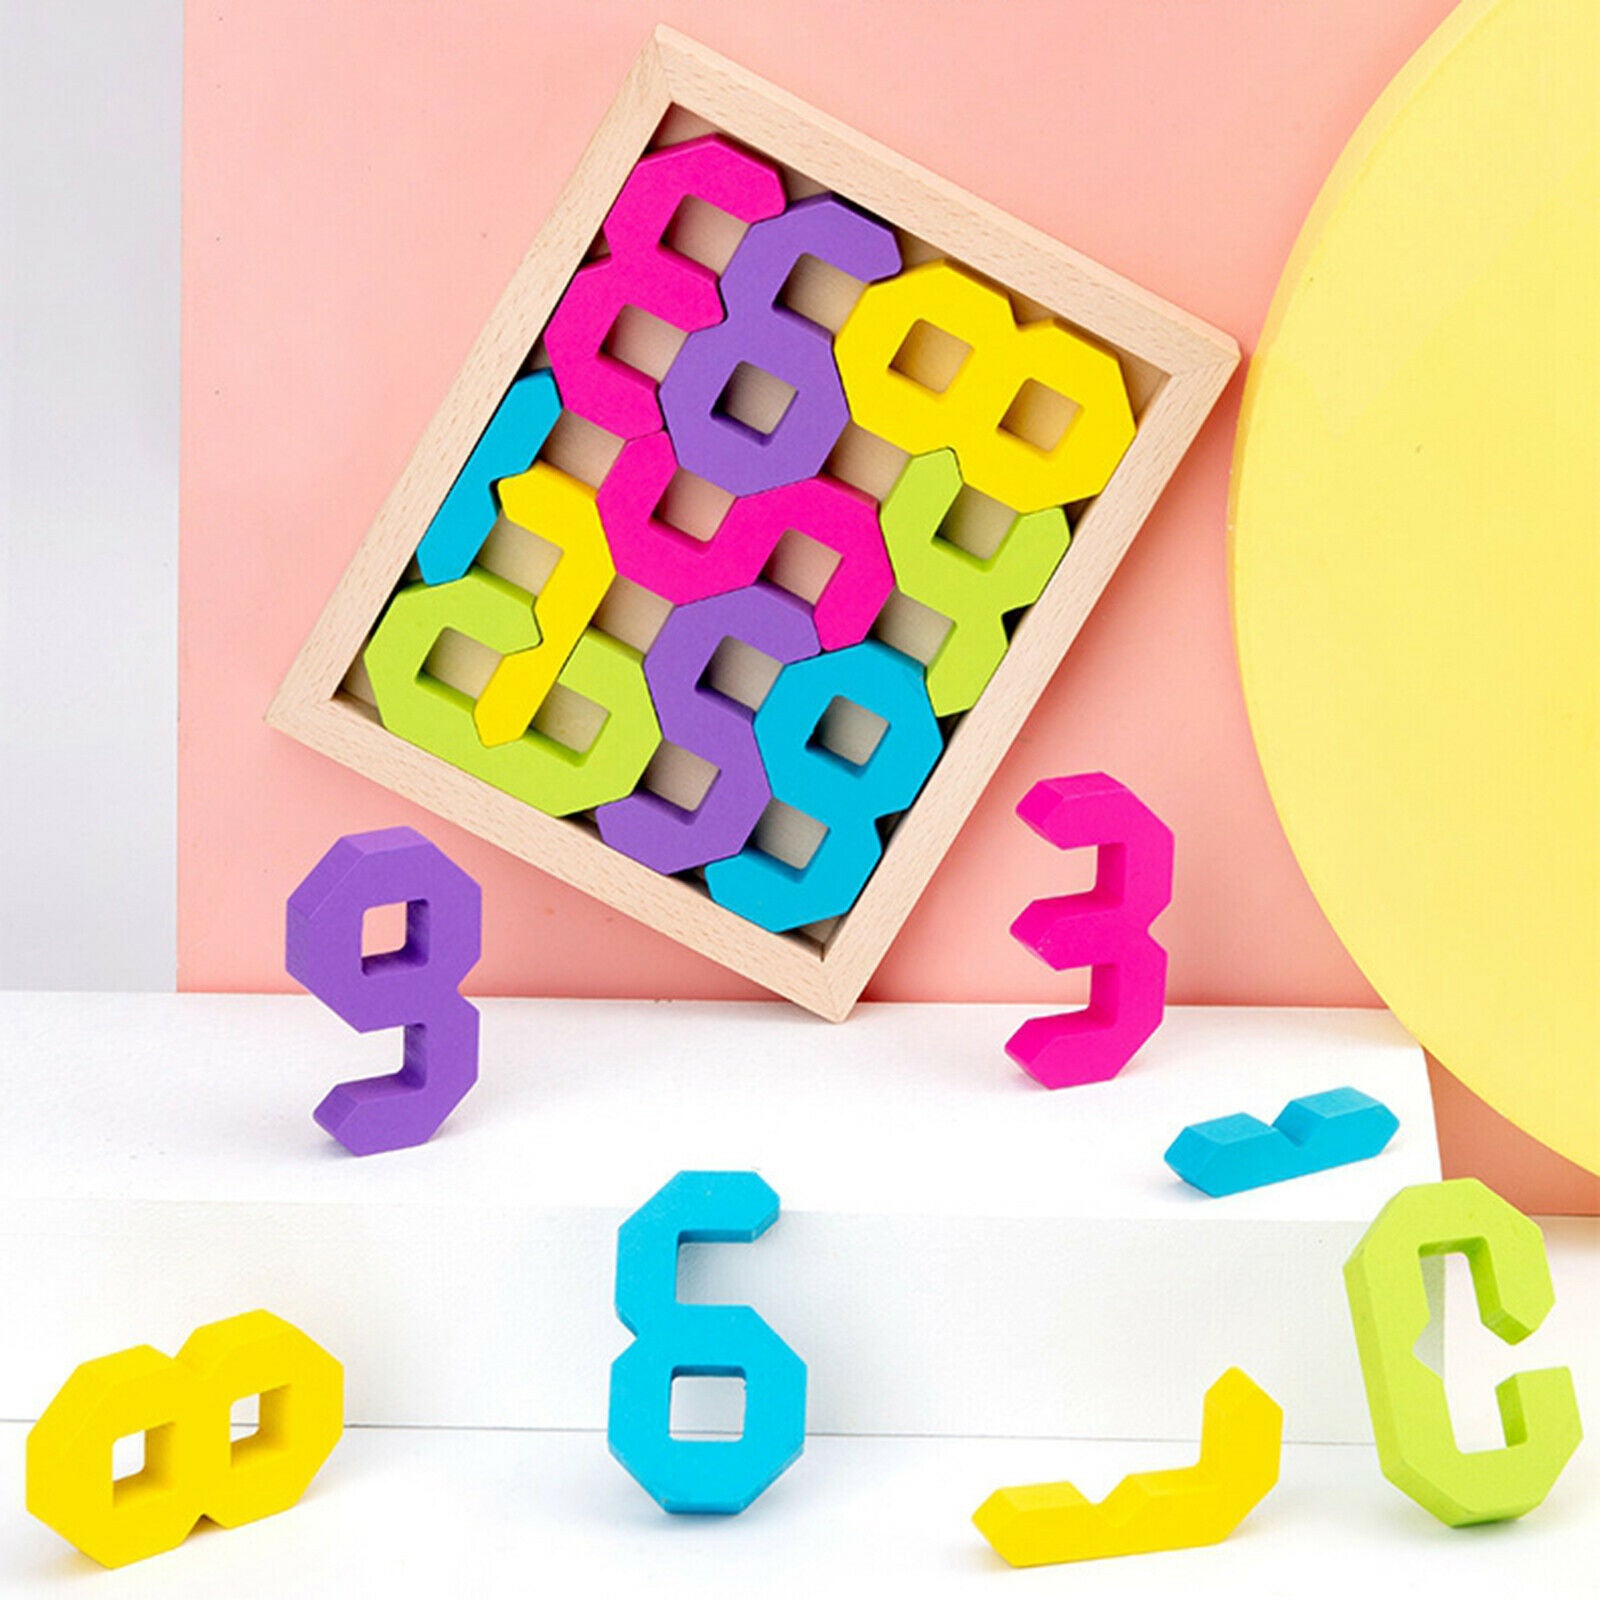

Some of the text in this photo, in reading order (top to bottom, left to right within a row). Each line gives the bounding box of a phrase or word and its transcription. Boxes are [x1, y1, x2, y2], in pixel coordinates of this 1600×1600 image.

[834, 258, 1137, 514] 8
[285, 825, 482, 1157] 9
[1004, 771, 1175, 1090] 3
[25, 1309, 344, 1569] 8
[607, 1170, 807, 1516] 6
